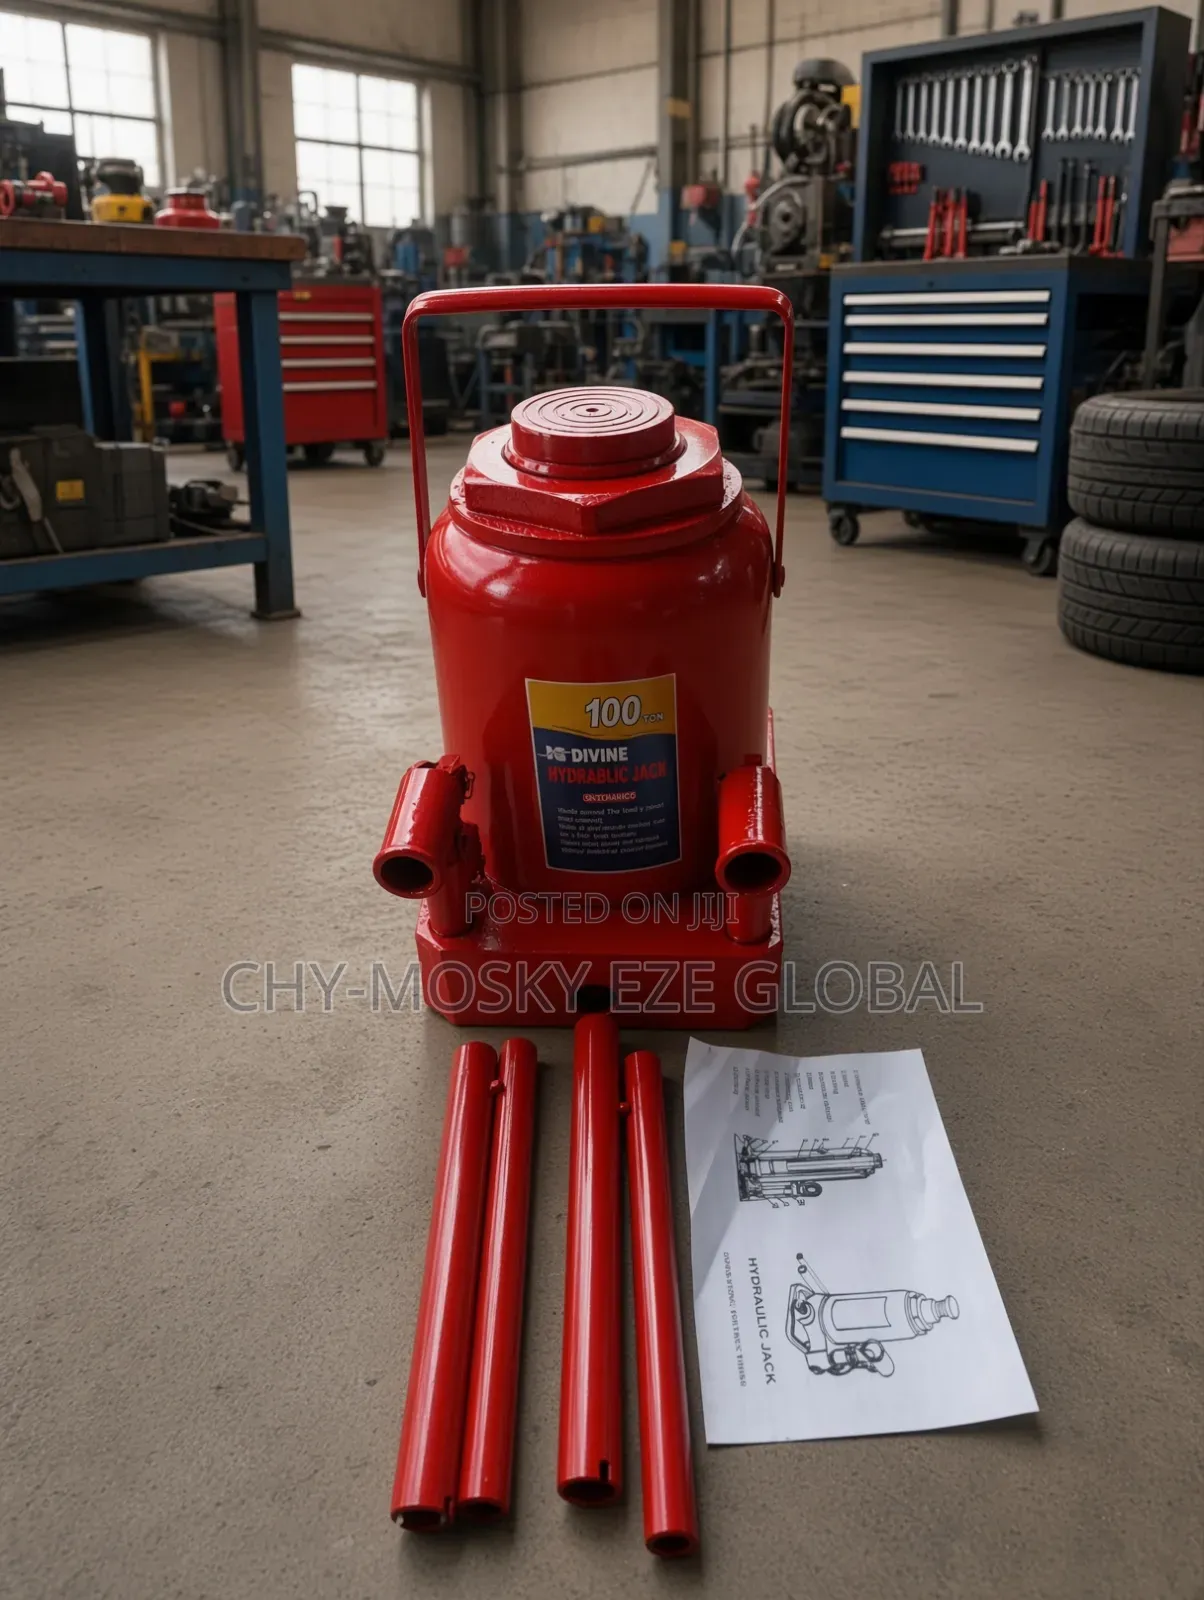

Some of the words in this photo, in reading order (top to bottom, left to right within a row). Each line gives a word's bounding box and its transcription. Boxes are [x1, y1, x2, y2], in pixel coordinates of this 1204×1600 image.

[585, 695, 642, 728] 100
[642, 712, 664, 723] TON
[571, 747, 629, 763] DIVINE
[748, 1257, 769, 1339] HYDRAULIC
[761, 1342, 777, 1386] JACK
